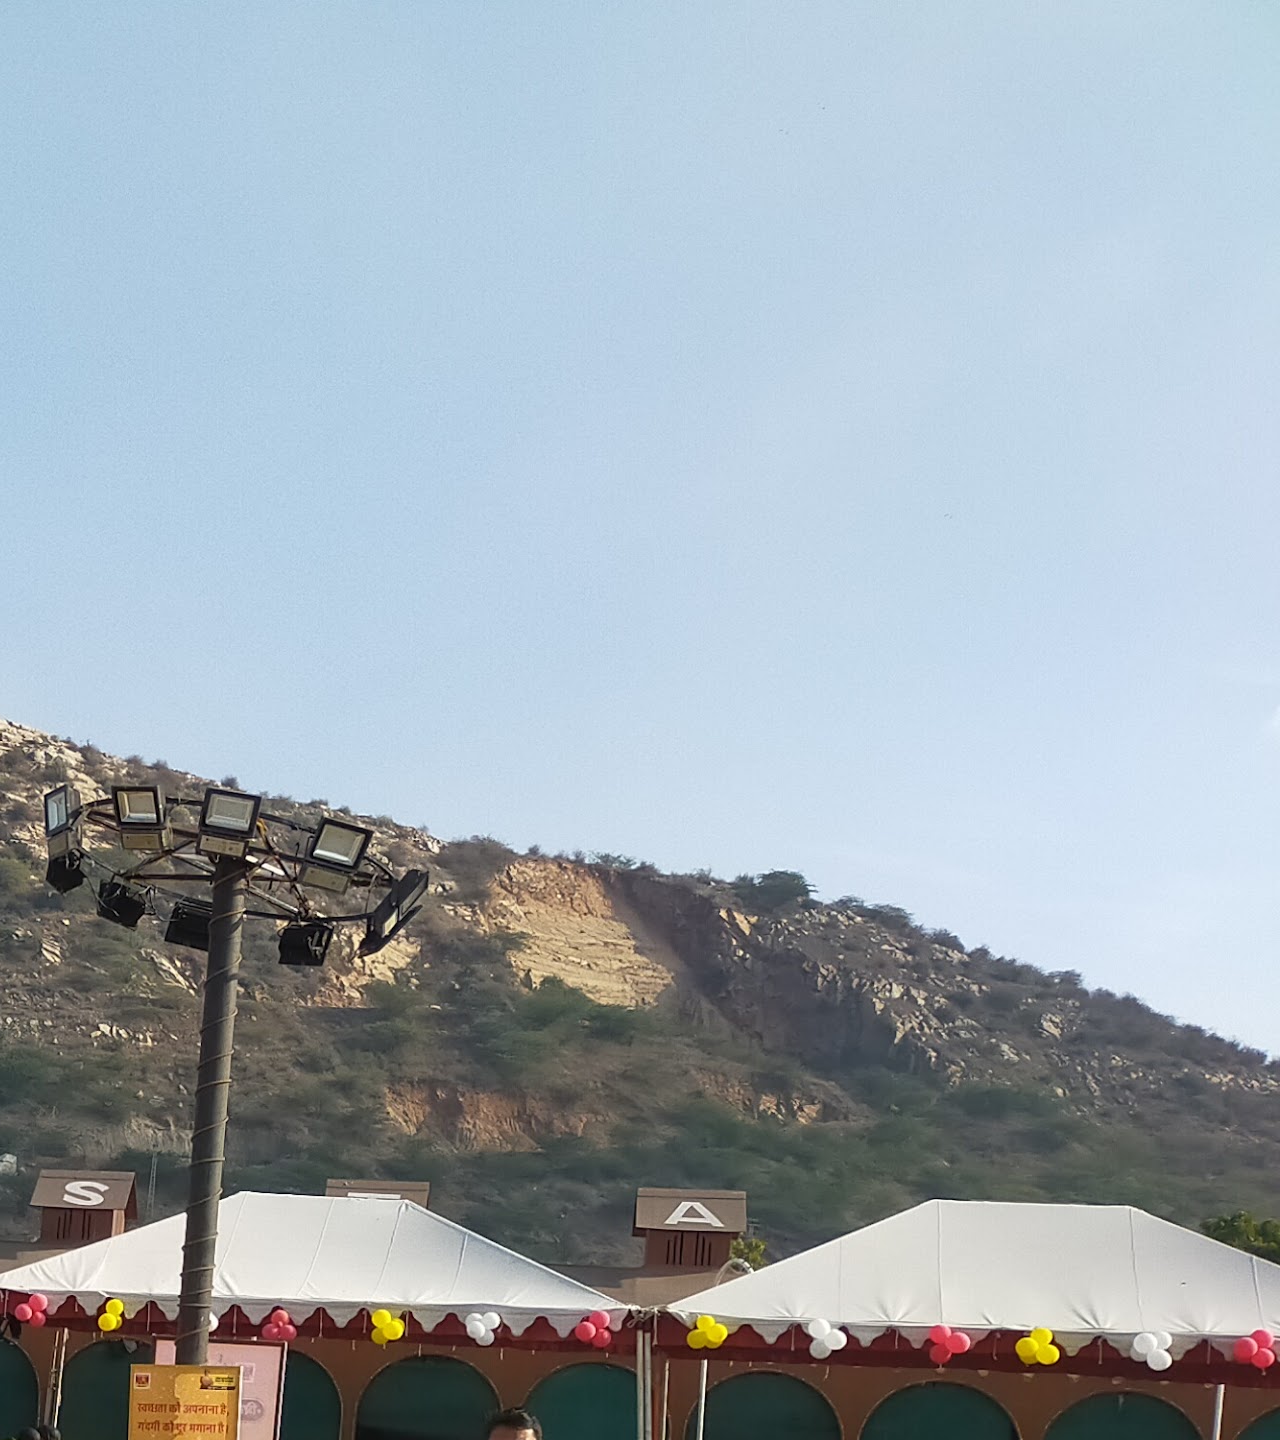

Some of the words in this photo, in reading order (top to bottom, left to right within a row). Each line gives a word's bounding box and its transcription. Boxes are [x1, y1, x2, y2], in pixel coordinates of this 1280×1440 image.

[63, 1181, 109, 1206] S
[664, 1201, 725, 1227] A
[169, 1401, 180, 1414] को
[183, 1404, 219, 1415] अपनाना
[162, 1420, 174, 1433] को
